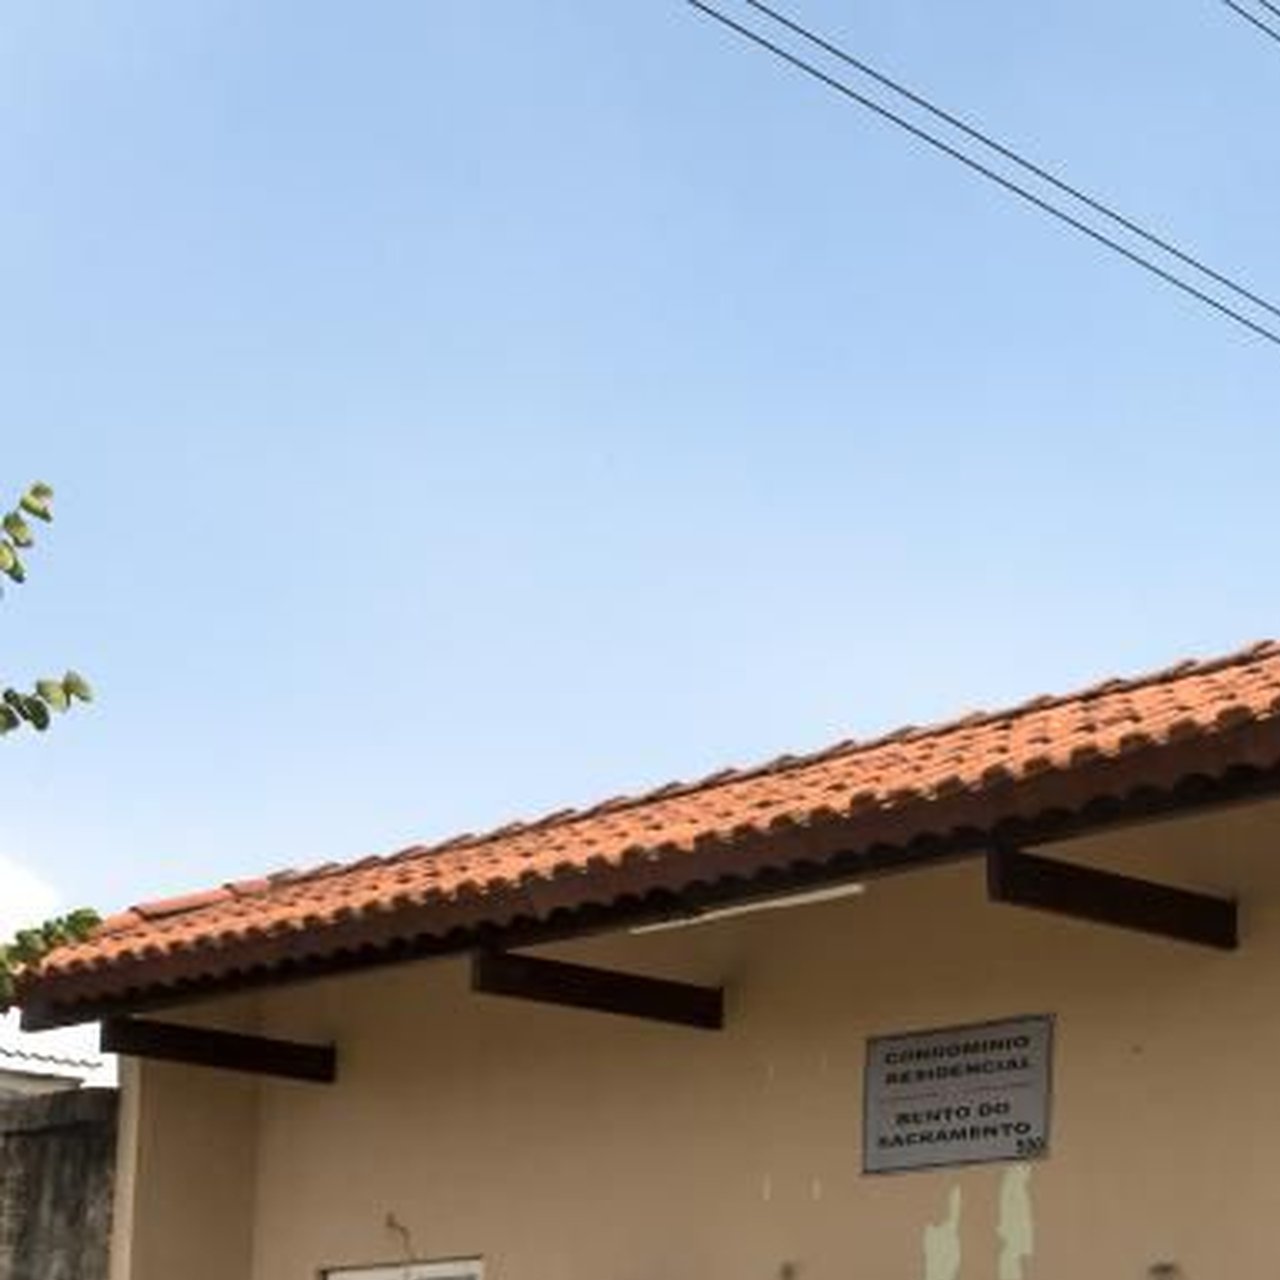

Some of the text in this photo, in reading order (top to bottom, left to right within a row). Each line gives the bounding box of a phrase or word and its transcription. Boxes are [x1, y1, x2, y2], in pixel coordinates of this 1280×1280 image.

[885, 1056, 1030, 1085] RESIDENCIAL
[979, 1102, 1011, 1117] DO
[877, 1121, 1032, 1148] SACRAMENTO
